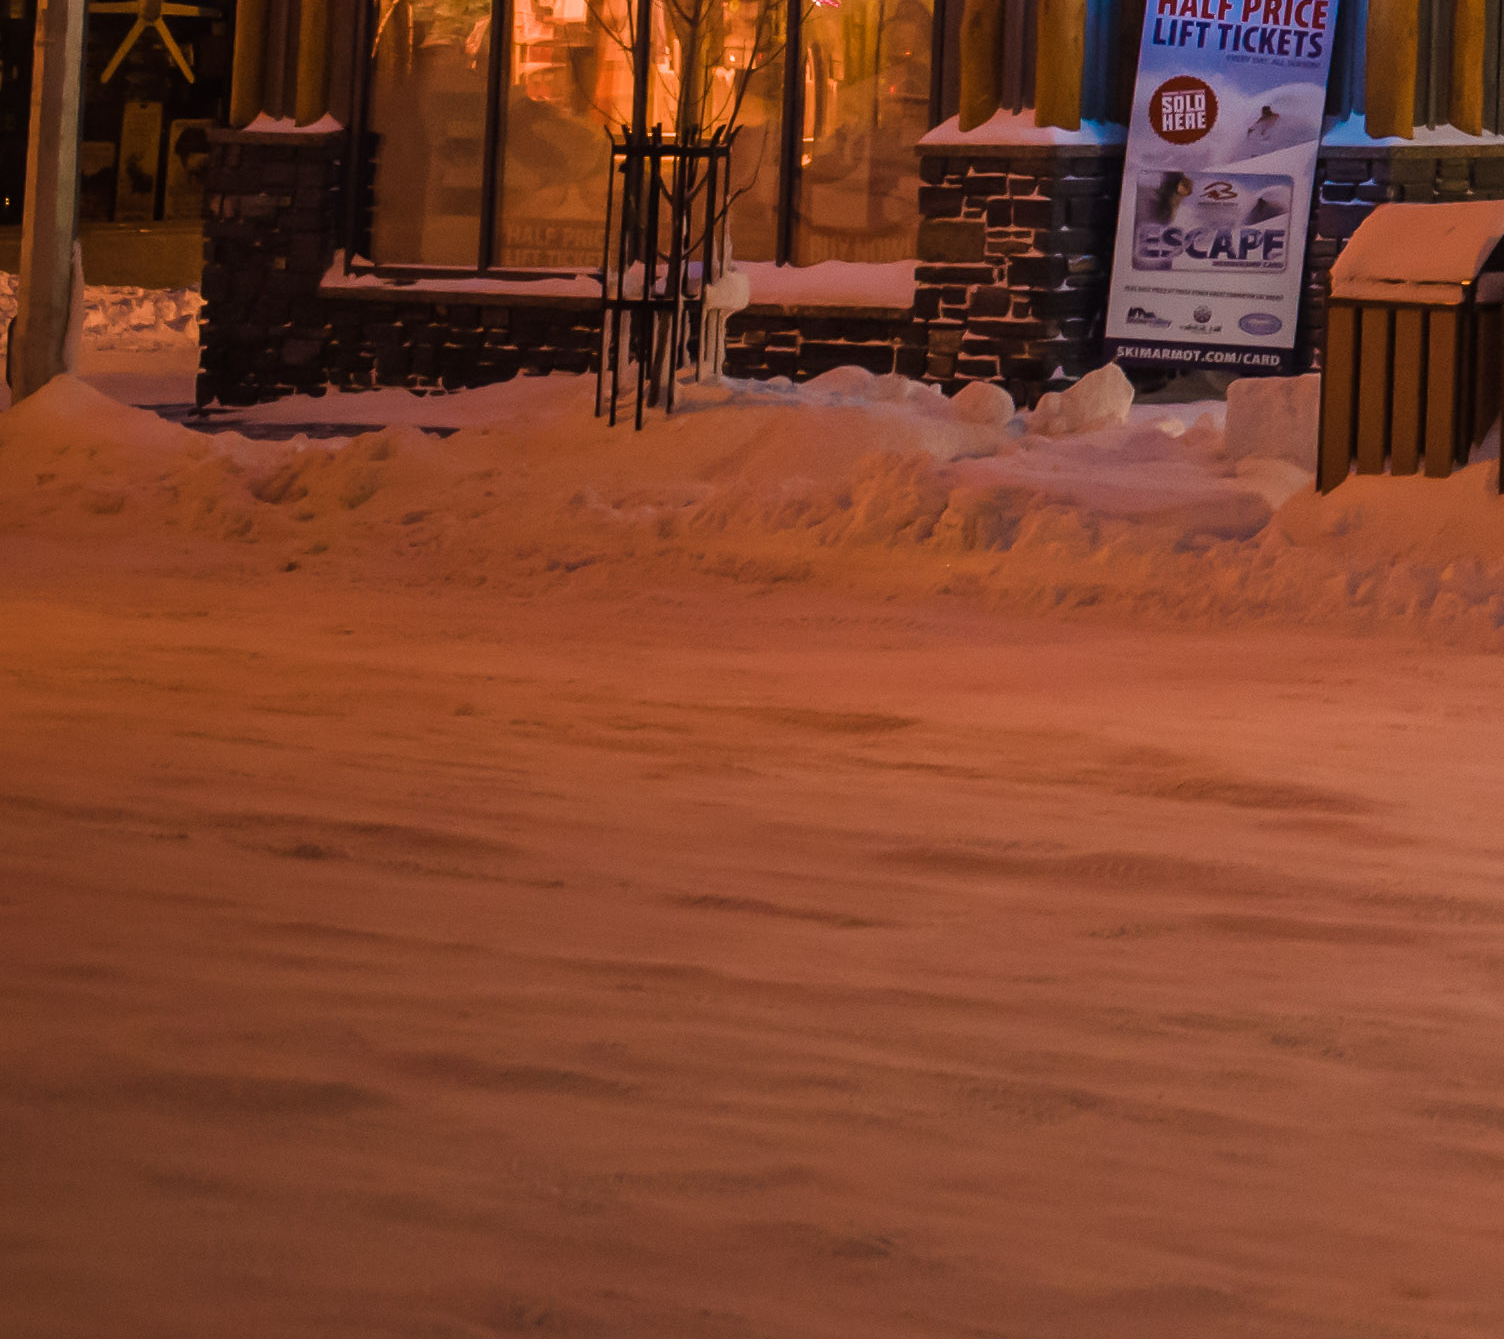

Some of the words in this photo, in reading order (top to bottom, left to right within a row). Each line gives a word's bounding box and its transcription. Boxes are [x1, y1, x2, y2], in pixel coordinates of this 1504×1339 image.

[1152, 18, 1212, 49] LIFT
[1217, 23, 1324, 59] TICKETS
[1161, 94, 1207, 114] SOLD
[1162, 112, 1207, 132] HERE
[1139, 226, 1286, 261] ESCAPE
[1116, 345, 1281, 366] SKIMARMOT.COM/CARD
